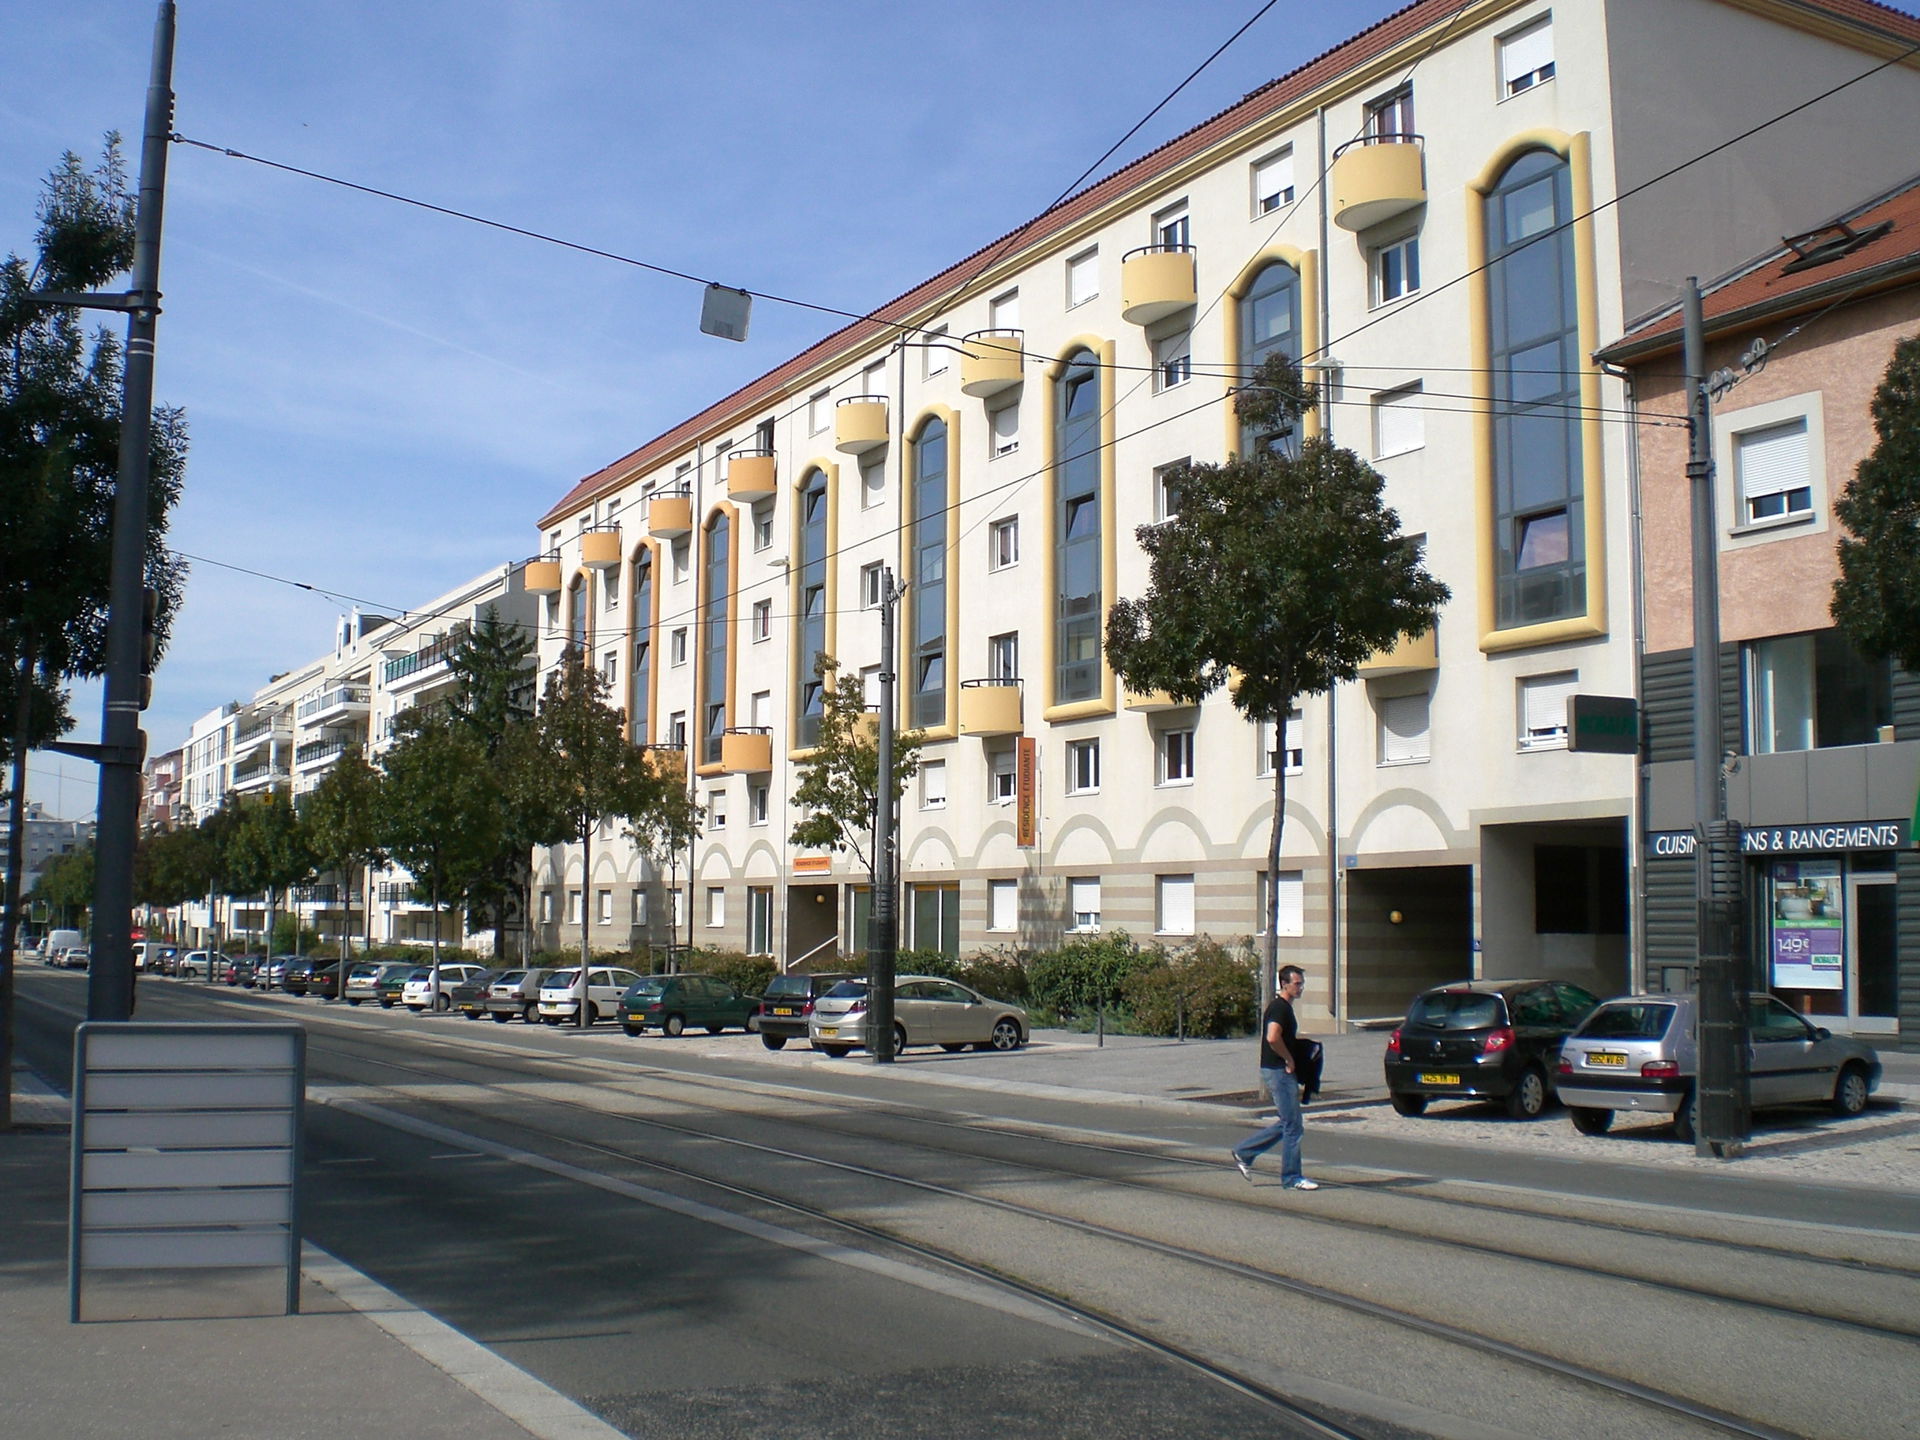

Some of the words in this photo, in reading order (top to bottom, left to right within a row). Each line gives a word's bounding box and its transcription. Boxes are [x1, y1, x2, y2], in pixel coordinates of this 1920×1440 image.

[1742, 831, 1768, 851] NS
[1772, 831, 1784, 850] &
[1789, 825, 1899, 850] RANGEMENTS
